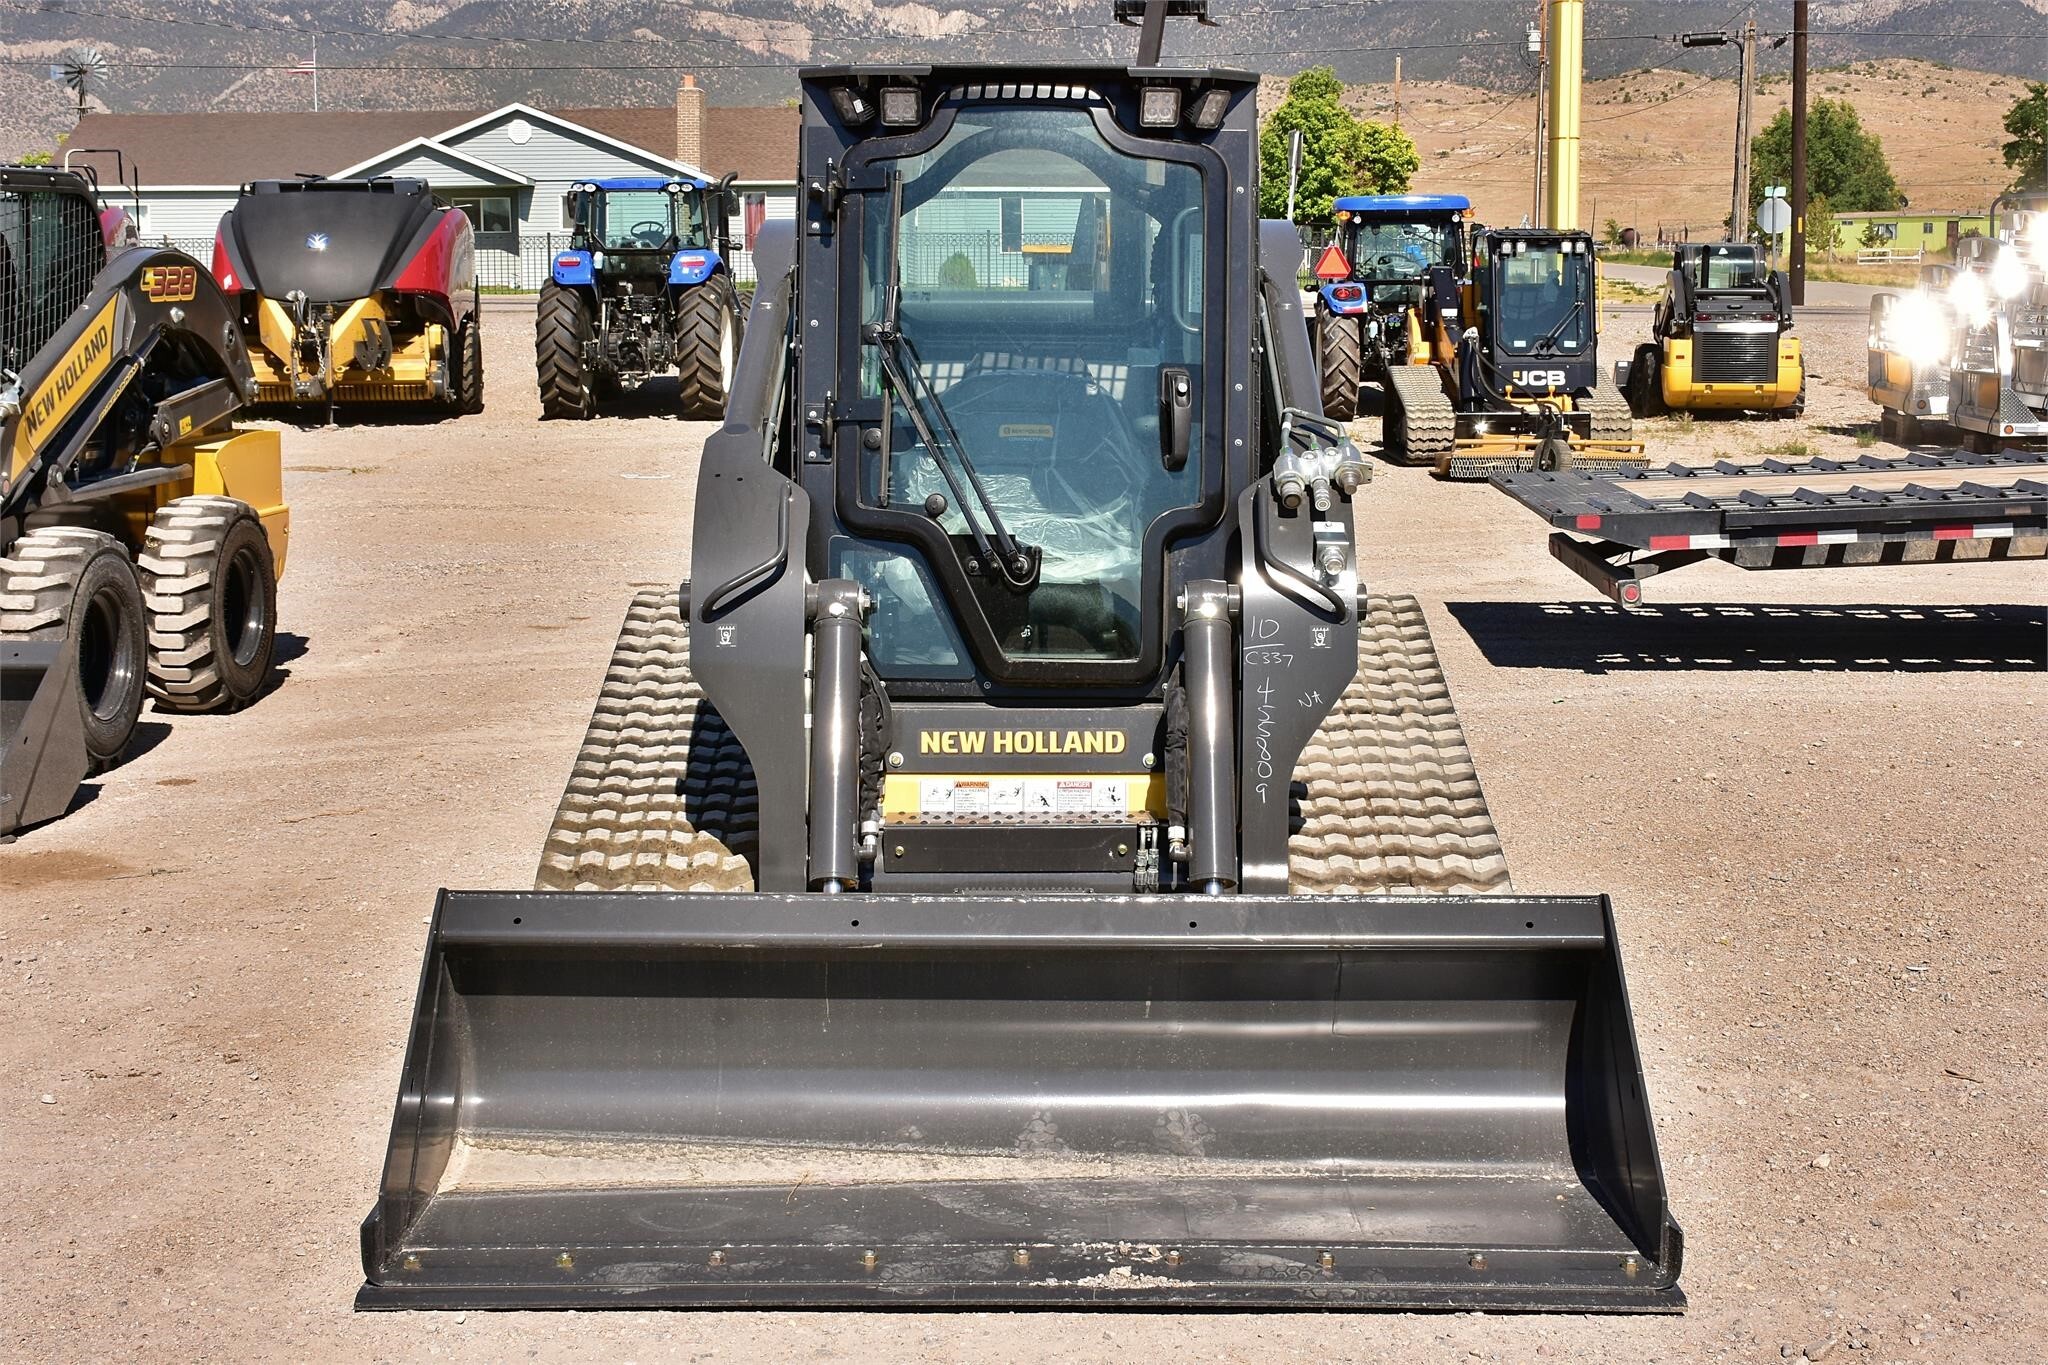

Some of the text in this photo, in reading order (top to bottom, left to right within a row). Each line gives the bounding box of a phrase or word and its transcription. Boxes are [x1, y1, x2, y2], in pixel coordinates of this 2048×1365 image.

[142, 266, 197, 302] L328
[25, 325, 109, 437] NEW HOLLAND
[1513, 370, 1566, 386] JCB
[1250, 615, 1280, 639] 10
[1244, 651, 1294, 668] C337
[920, 730, 1126, 754] NEW HOLLAND
